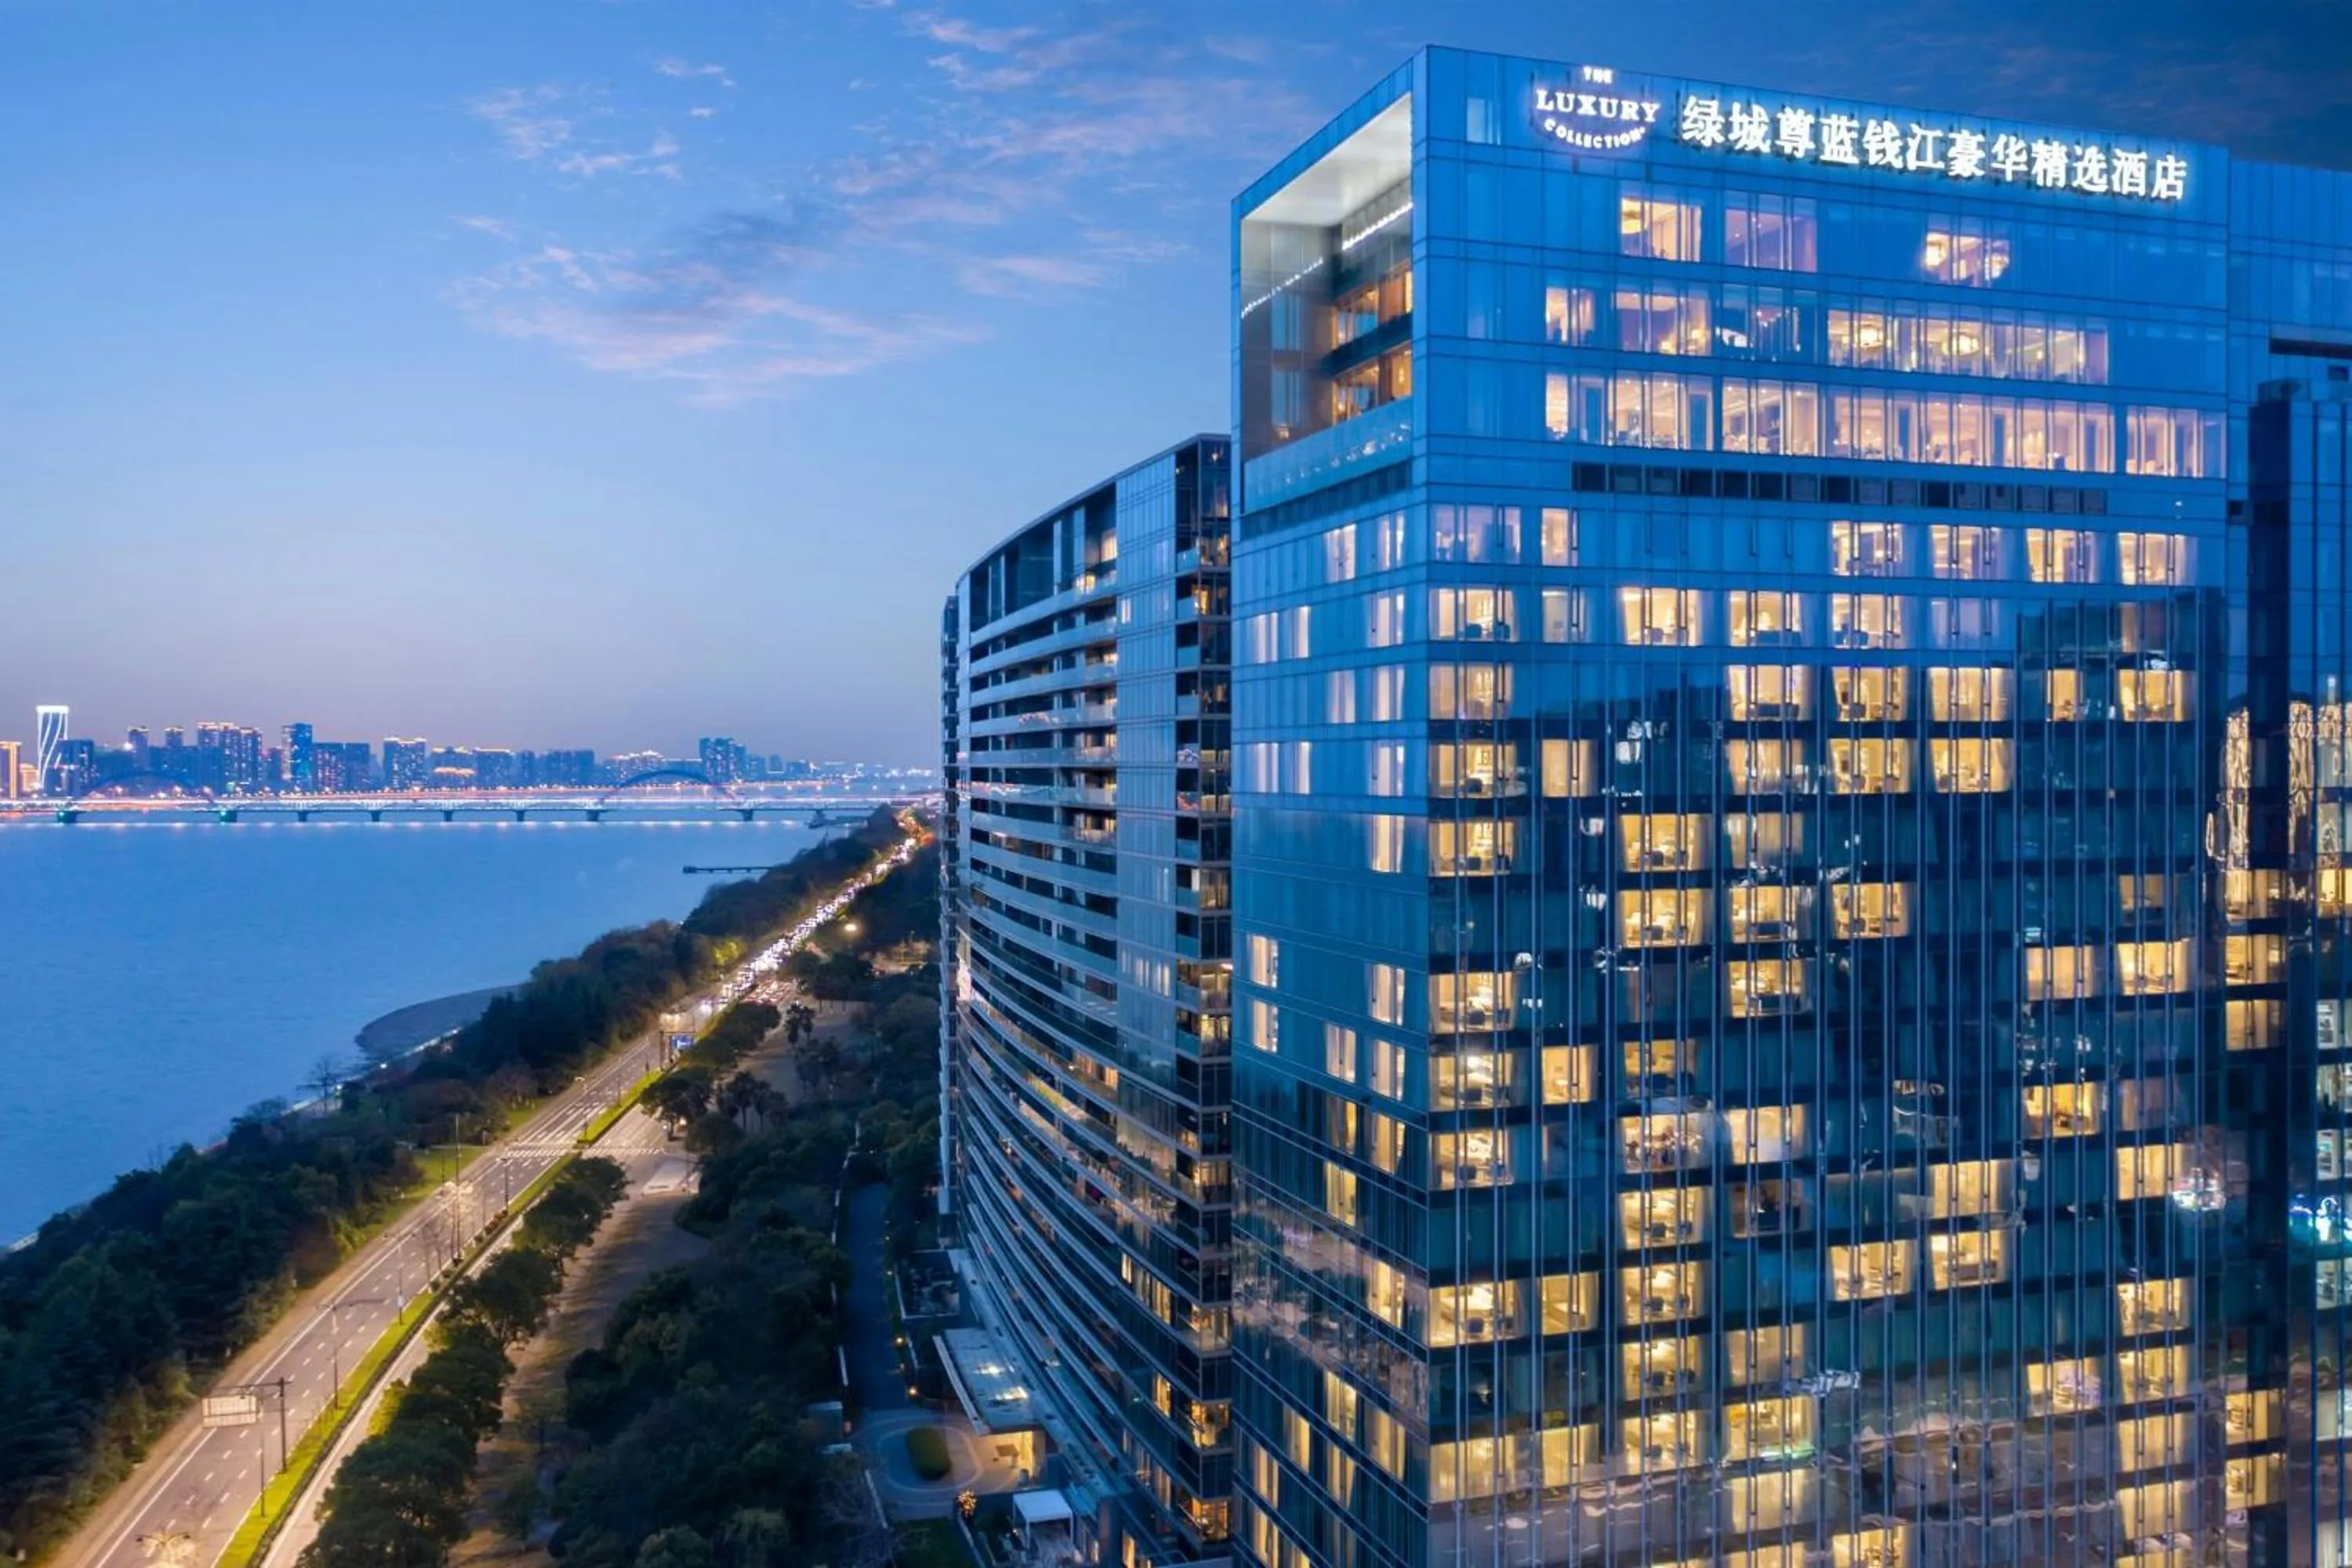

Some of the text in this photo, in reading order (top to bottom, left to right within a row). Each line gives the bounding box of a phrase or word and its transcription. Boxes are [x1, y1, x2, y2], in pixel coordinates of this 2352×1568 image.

[1536, 88, 1661, 122] LUXURY
[1682, 95, 2187, 199] 绿城尊蓝钱江豪华精选酒店
